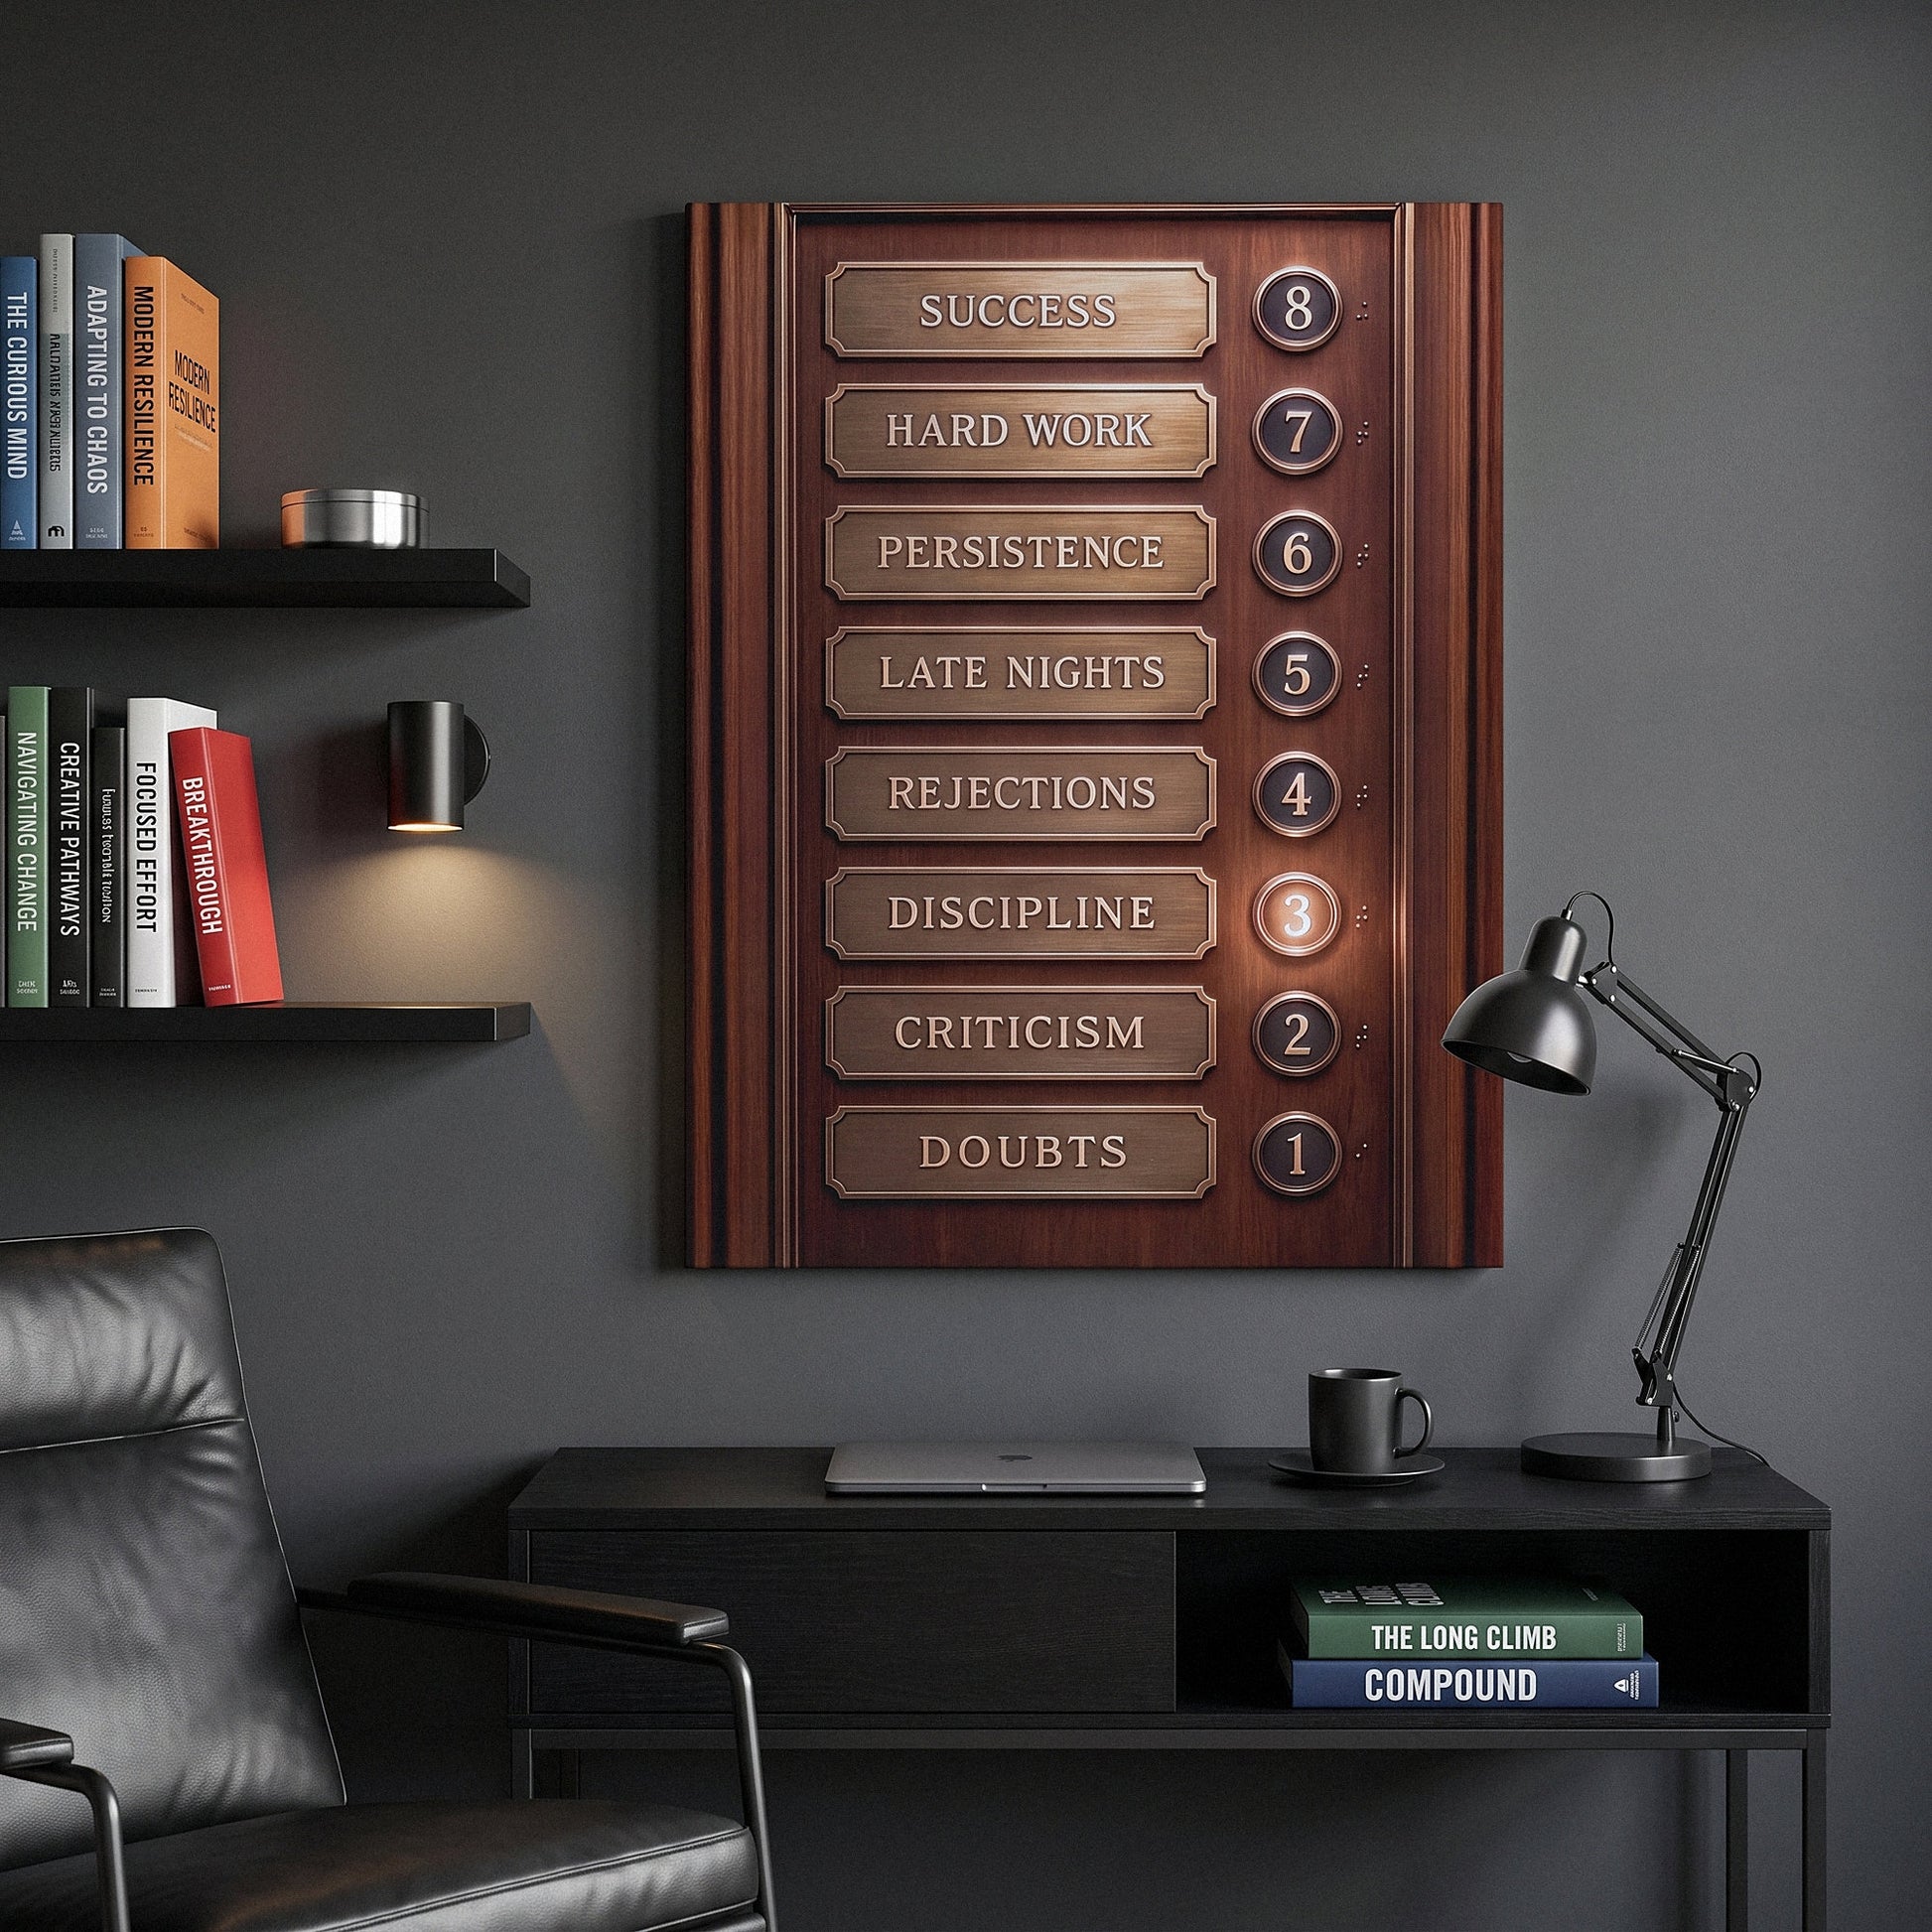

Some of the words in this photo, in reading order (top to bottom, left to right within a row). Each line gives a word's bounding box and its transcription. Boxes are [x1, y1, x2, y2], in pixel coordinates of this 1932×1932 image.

[7, 292, 28, 329] THE
[134, 286, 154, 367] MODERN
[920, 294, 1116, 329] SUCCESS
[1283, 285, 1313, 331] 8
[86, 285, 108, 387] ADAPTING
[7, 334, 28, 423] CURIOUS
[174, 349, 210, 395] MODERN
[86, 394, 108, 420] TO
[168, 381, 216, 434] RESILIENCE
[134, 374, 154, 486] RESILIENCE
[887, 413, 1009, 447] HARD
[1023, 413, 1153, 447] WORK
[1284, 410, 1312, 454] 7
[7, 429, 28, 480] MIND
[86, 425, 108, 494] CHAOS
[877, 534, 1165, 570] PERSISTENCE
[1282, 531, 1312, 575] 6
[880, 655, 988, 689] LATE
[1006, 654, 1166, 690] NIGHTS
[1283, 653, 1311, 696] 5
[17, 732, 37, 847] NAVIGATING
[60, 742, 80, 831] CREATIVE
[136, 762, 157, 852] FOCUSED
[888, 775, 1157, 810] REJECTIONS
[1282, 771, 1312, 817] 4
[182, 776, 223, 935] BREAKTHROUGH
[17, 853, 37, 932] CHANGE
[60, 837, 80, 937] PATHWAYS
[136, 859, 157, 933] EFFORT
[888, 896, 1157, 930] DISCIPLINE
[1283, 894, 1312, 938] 3
[895, 1015, 1146, 1050] CRITICISM
[1284, 1013, 1311, 1056] 2
[919, 1134, 1127, 1169] DOUBTS
[1287, 1132, 1307, 1175] 1
[1371, 1624, 1413, 1650] THE
[1421, 1624, 1478, 1650] LONG
[1486, 1624, 1557, 1650] CLIMB
[1364, 1668, 1538, 1702] COMPOUND
